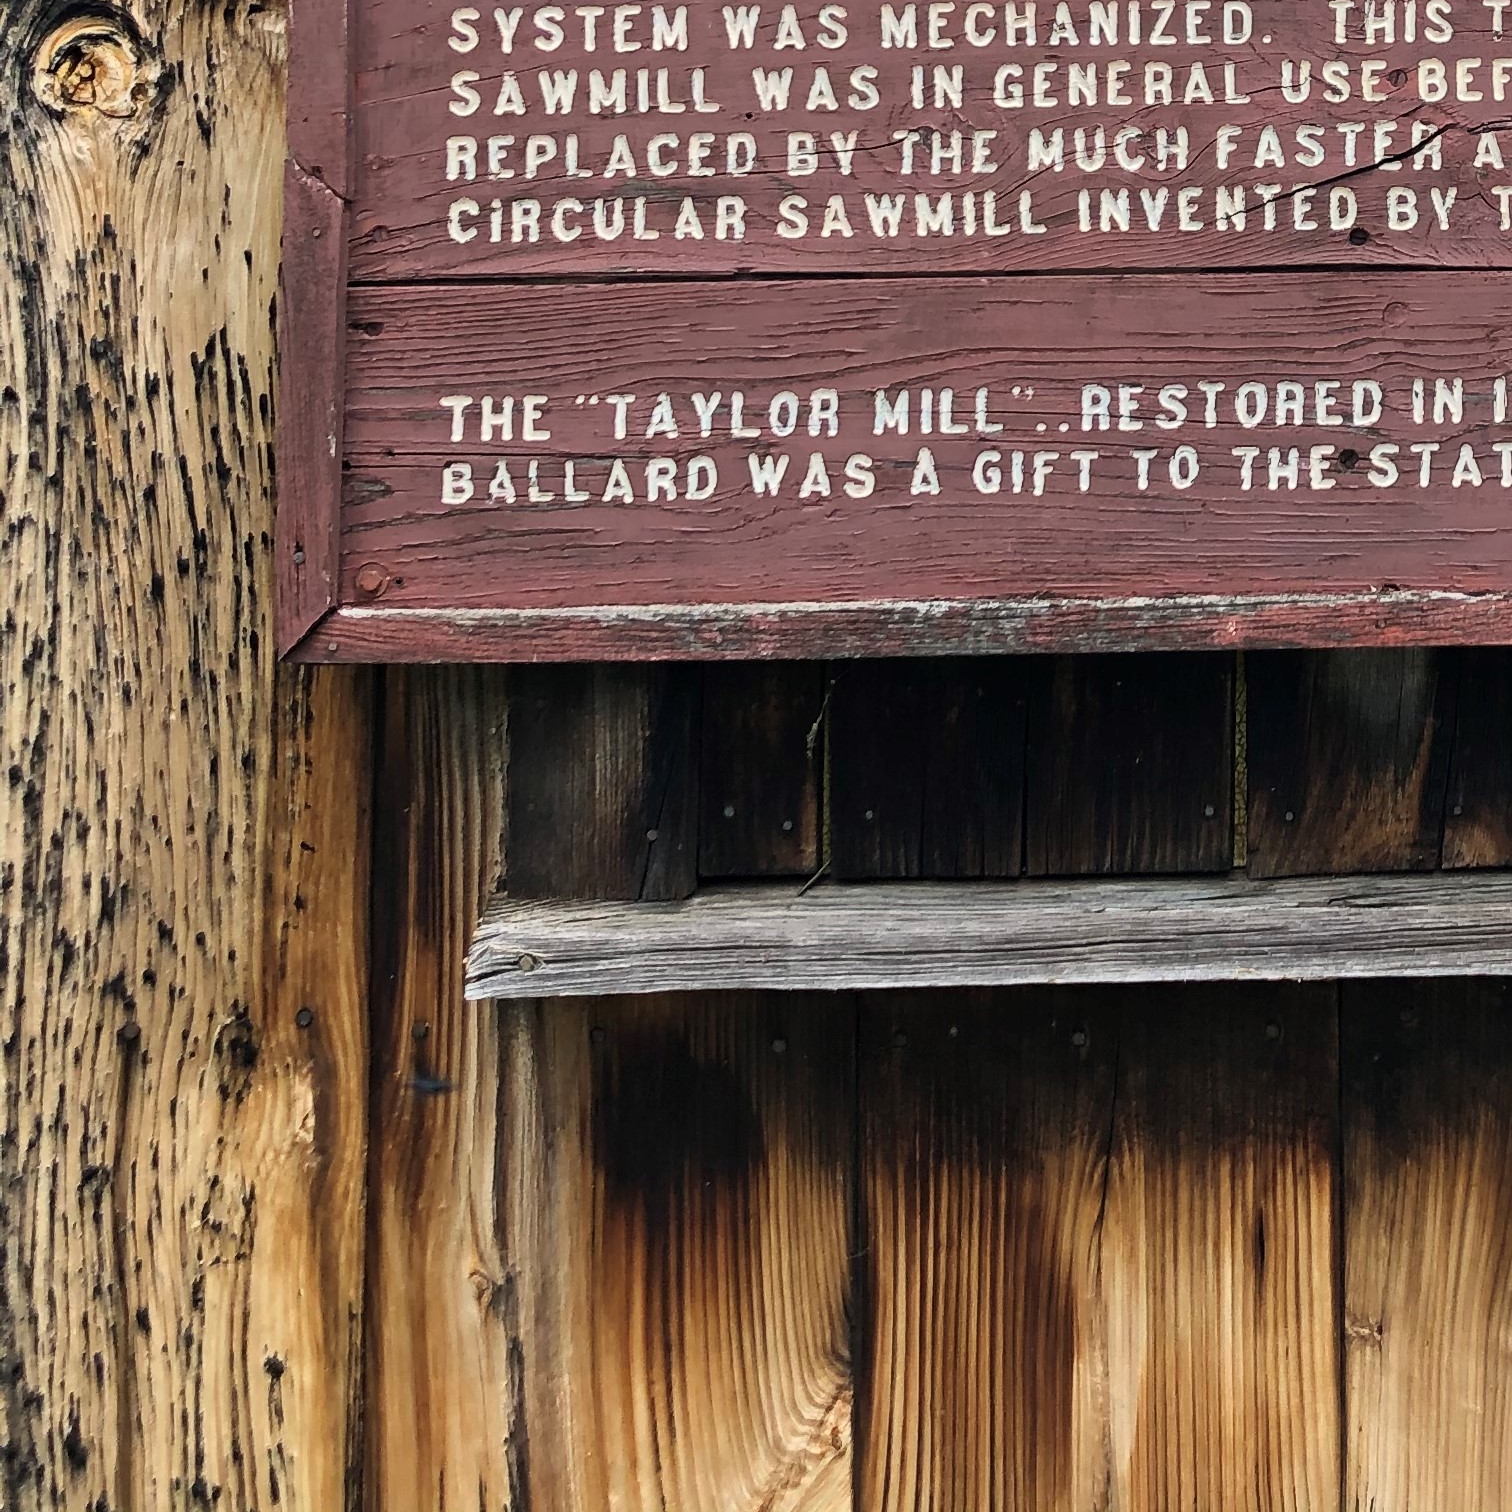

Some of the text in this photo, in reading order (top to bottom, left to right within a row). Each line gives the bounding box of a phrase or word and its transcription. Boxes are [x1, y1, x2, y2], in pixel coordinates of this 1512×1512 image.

[448, 5, 687, 54] SYSTEM
[722, 5, 847, 50] WAS
[881, 0, 1271, 49] MECHANIZED.
[449, 68, 720, 116] SAWMILL
[752, 65, 879, 111] WAS
[911, 65, 963, 109] IN
[993, 60, 1249, 108] GENERAL
[1281, 59, 1387, 103] USE
[446, 133, 756, 181] REPLACED
[787, 130, 857, 176] BY
[893, 130, 998, 175] THE
[1028, 124, 1188, 173] MUCH
[1216, 120, 1442, 171] FASTER
[447, 196, 747, 244] CIRCULAR
[777, 190, 1047, 238] SAWMILL
[1078, 183, 1357, 232] INVENTED
[1387, 187, 1457, 231] BY
[440, 395, 550, 442] THE
[1410, 378, 1463, 424] IN
[442, 456, 717, 509] BALLARD
[748, 453, 875, 498] WAS
[910, 447, 940, 495] A
[973, 451, 1098, 496] GIFT
[1130, 446, 1199, 490] TO
[1232, 445, 1335, 490] THE
